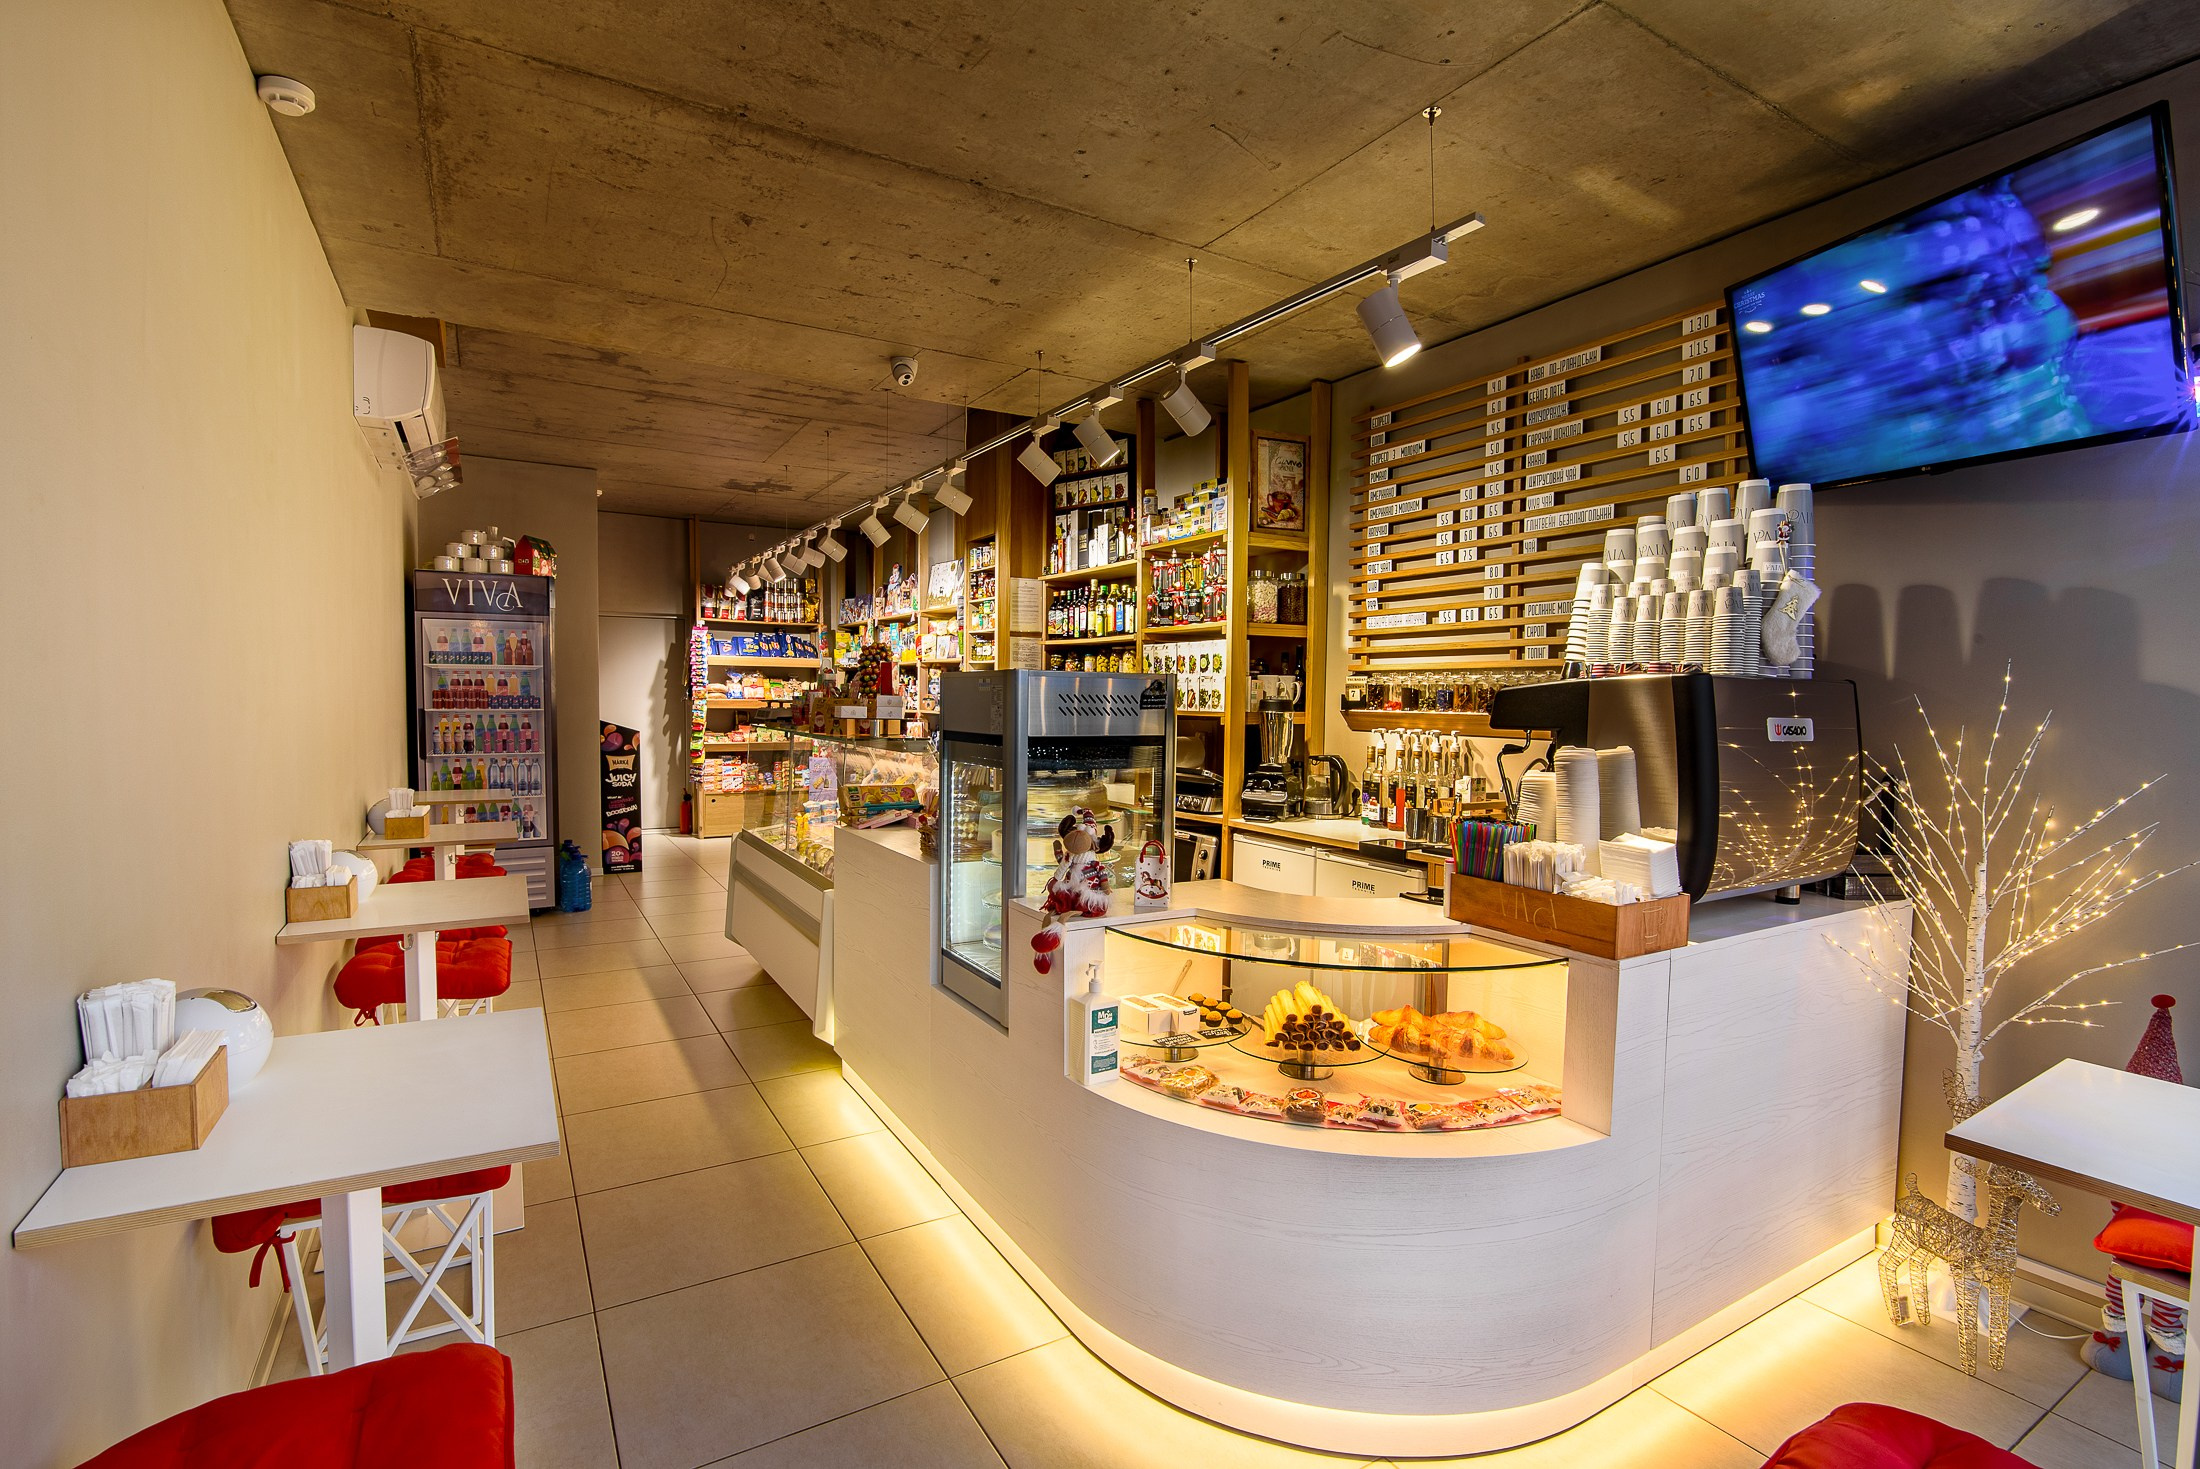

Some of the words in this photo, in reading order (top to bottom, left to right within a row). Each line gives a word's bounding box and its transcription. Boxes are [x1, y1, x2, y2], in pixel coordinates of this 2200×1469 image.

[1689, 314, 1709, 333] 130
[1689, 339, 1709, 358] 115
[1530, 366, 1545, 381] КАВА
[1690, 366, 1703, 382] 70
[1492, 380, 1502, 393] 40
[1529, 387, 1548, 404] БЕЙЛІЗ
[1549, 383, 1565, 398] ЛАТЕ
[1689, 391, 1702, 406] 65
[1491, 400, 1502, 413] 60
[1657, 400, 1670, 414] 60
[1371, 413, 1391, 429] ЕСПРЕСО
[1623, 409, 1635, 423] 55
[1491, 420, 1500, 434] 45
[1689, 416, 1703, 431] 65
[1528, 428, 1552, 447] ГАРЯЧИЙ
[1553, 422, 1582, 440] ШОКОЛАД
[1656, 424, 1669, 439] 60
[1623, 432, 1635, 446] 55
[1371, 451, 1390, 465] ЕСПРЕСО
[1392, 449, 1396, 460] З
[1400, 443, 1423, 458] МОЛОКОМ
[1490, 442, 1500, 455] 50
[1527, 452, 1545, 468] КАКАО
[1655, 448, 1669, 463] 65
[1489, 463, 1500, 475] 45
[1685, 467, 1700, 482] 60
[1370, 469, 1387, 483] РОМАНО
[1528, 468, 1564, 488] ЦИТРУСОВИЙ
[1565, 467, 1577, 481] ЧАЙ
[1369, 487, 1395, 502] АМЕРИКАНО
[1464, 489, 1473, 500] 50
[1489, 483, 1499, 496] 55
[1541, 494, 1553, 507] ЧАЙ
[1369, 505, 1394, 519] АМЕРИКАНО
[1398, 500, 1420, 514] МОЛОКОМ
[1464, 509, 1473, 521] 60
[1489, 504, 1498, 516] 65
[1440, 514, 1449, 524] 55
[1526, 515, 1556, 531] ГЛІНТВЕЙН
[1558, 504, 1612, 526] БЕЗАЛКОГОЛЬНИЙ
[1464, 529, 1473, 541] 60
[1488, 525, 1498, 537] 65
[1440, 533, 1449, 544] 55
[1368, 545, 1379, 556] ЛАТЕ
[1524, 540, 1536, 553] ЧАЙ
[1440, 553, 1449, 564] 65
[1464, 549, 1473, 561] 75
[1368, 563, 1379, 574] ФЛЕТ
[1489, 566, 1499, 578] 80
[441, 577, 524, 612] VIVA
[1488, 587, 1498, 599] 70
[1465, 609, 1474, 621] 60
[1488, 607, 1498, 619] 65
[1527, 602, 1556, 616] РОСЛИННЕ
[1557, 601, 1574, 614] МОЛО
[1443, 611, 1452, 622] 55
[1526, 625, 1545, 638] СИРОП
[1527, 647, 1546, 659] ТОПІНГ
[1351, 690, 1356, 698] 7
[605, 772, 637, 783] JUICY
[1262, 859, 1281, 869] PRIME
[1351, 879, 1376, 891] PRIME
